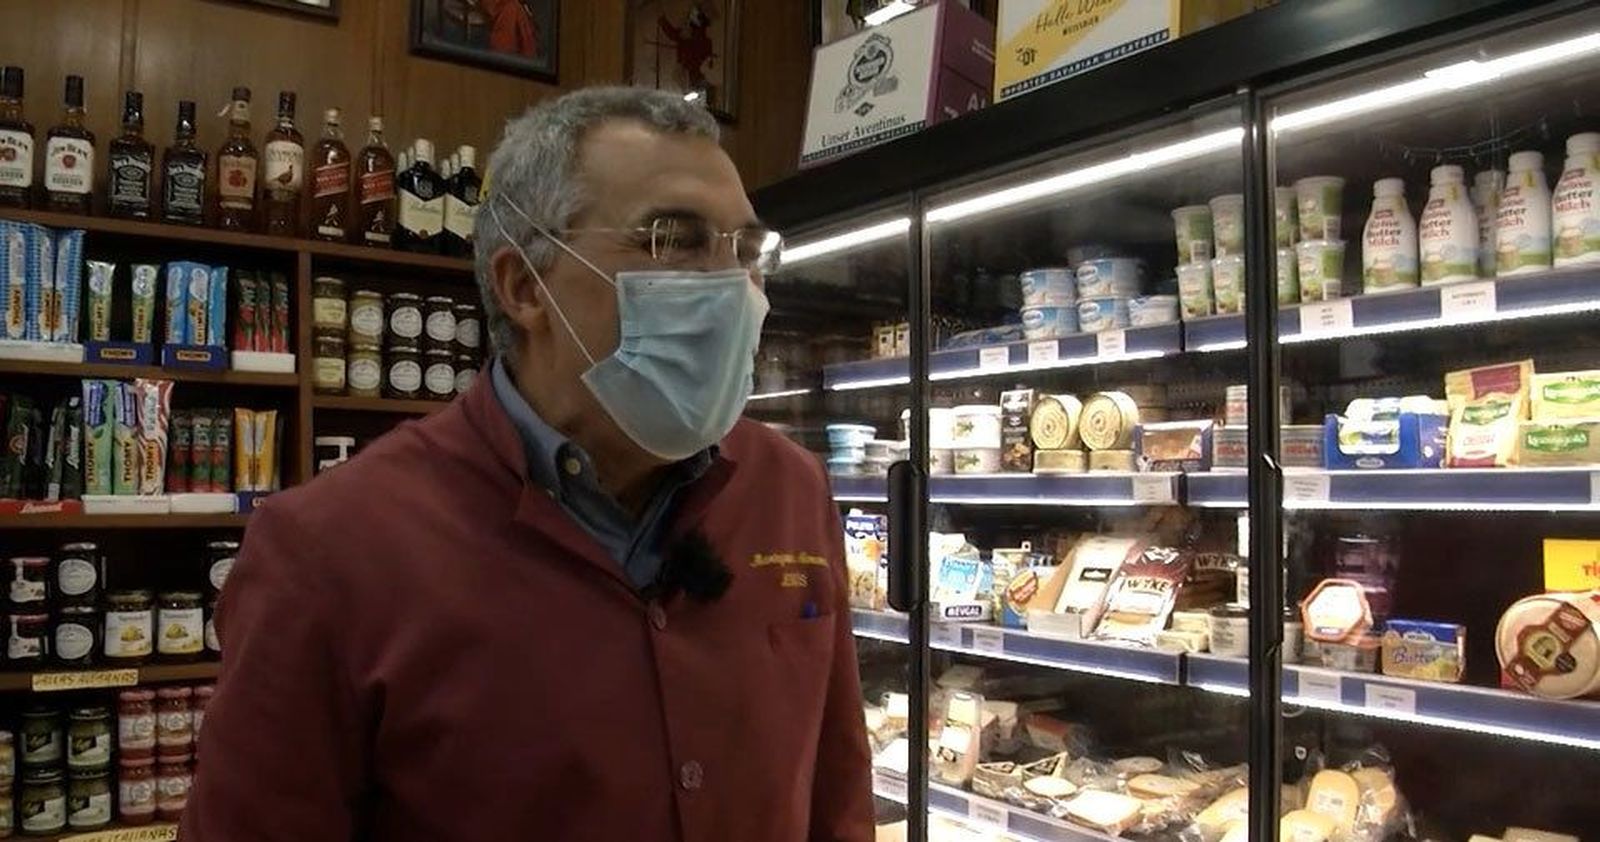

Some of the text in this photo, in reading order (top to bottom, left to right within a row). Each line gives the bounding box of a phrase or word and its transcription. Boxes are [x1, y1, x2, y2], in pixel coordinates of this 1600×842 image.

[1050, 55, 1100, 80] BAVARIAN
[820, 115, 906, 148] Unser Aventinus
[1368, 238, 1400, 248] Milch
[123, 441, 132, 482] THOMY
[145, 443, 154, 481] THOMY
[1127, 580, 1170, 592] WYKE
[1392, 646, 1440, 664] Butter
